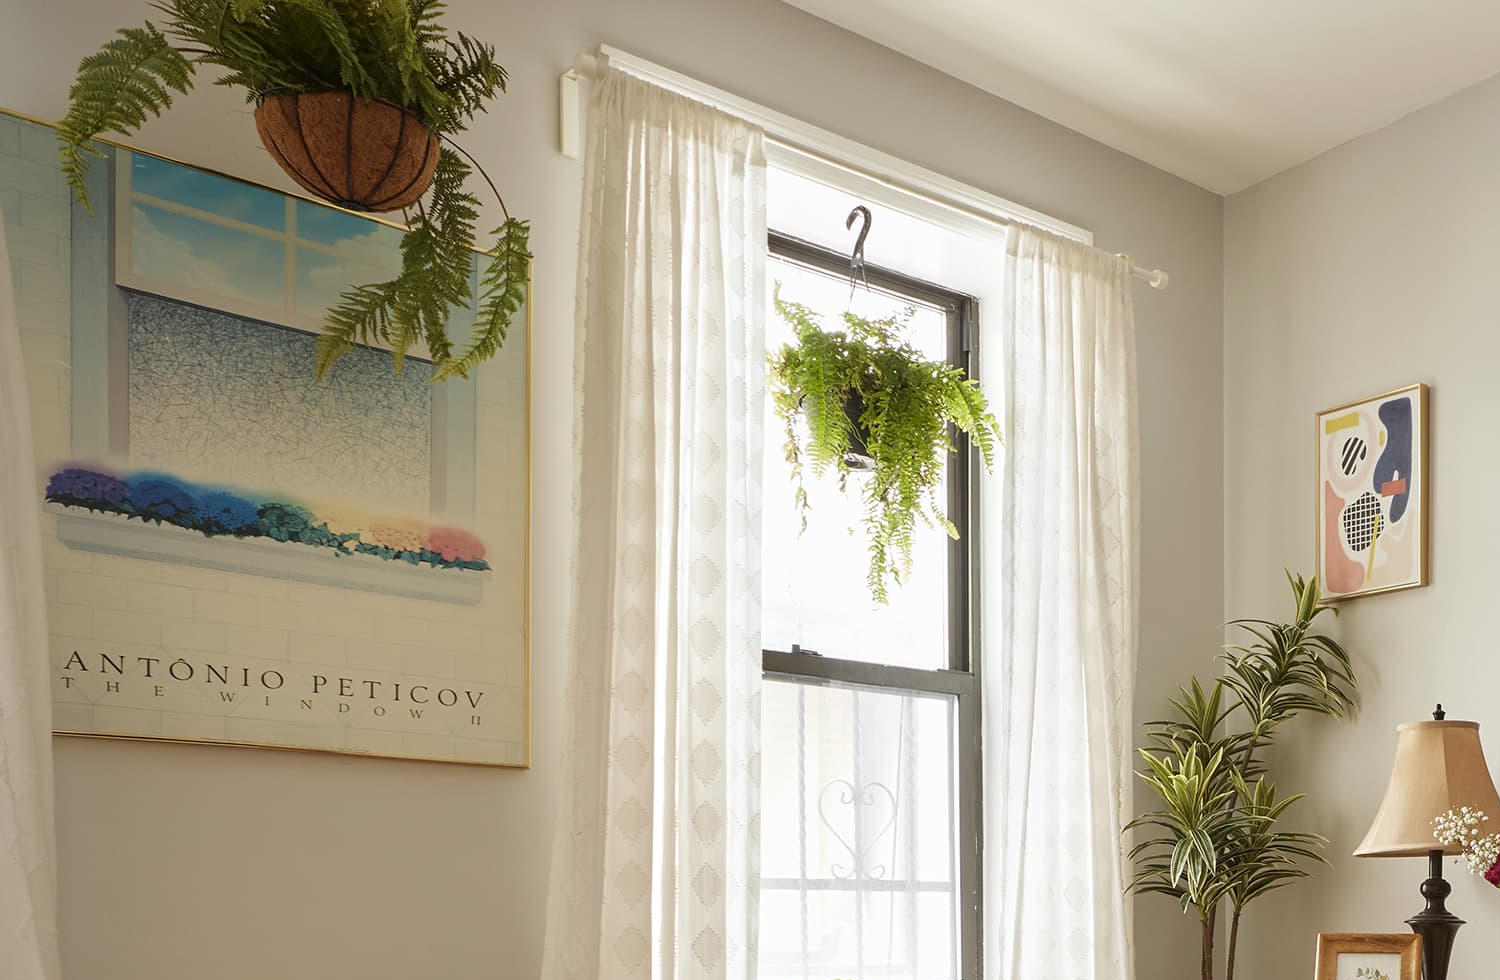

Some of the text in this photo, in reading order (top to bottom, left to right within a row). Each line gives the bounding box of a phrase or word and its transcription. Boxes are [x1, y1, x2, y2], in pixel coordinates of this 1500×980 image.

[61, 676, 165, 697] THE
[219, 690, 425, 720] WINDOW
[63, 649, 485, 709] ANTÔNIO PETICOV
